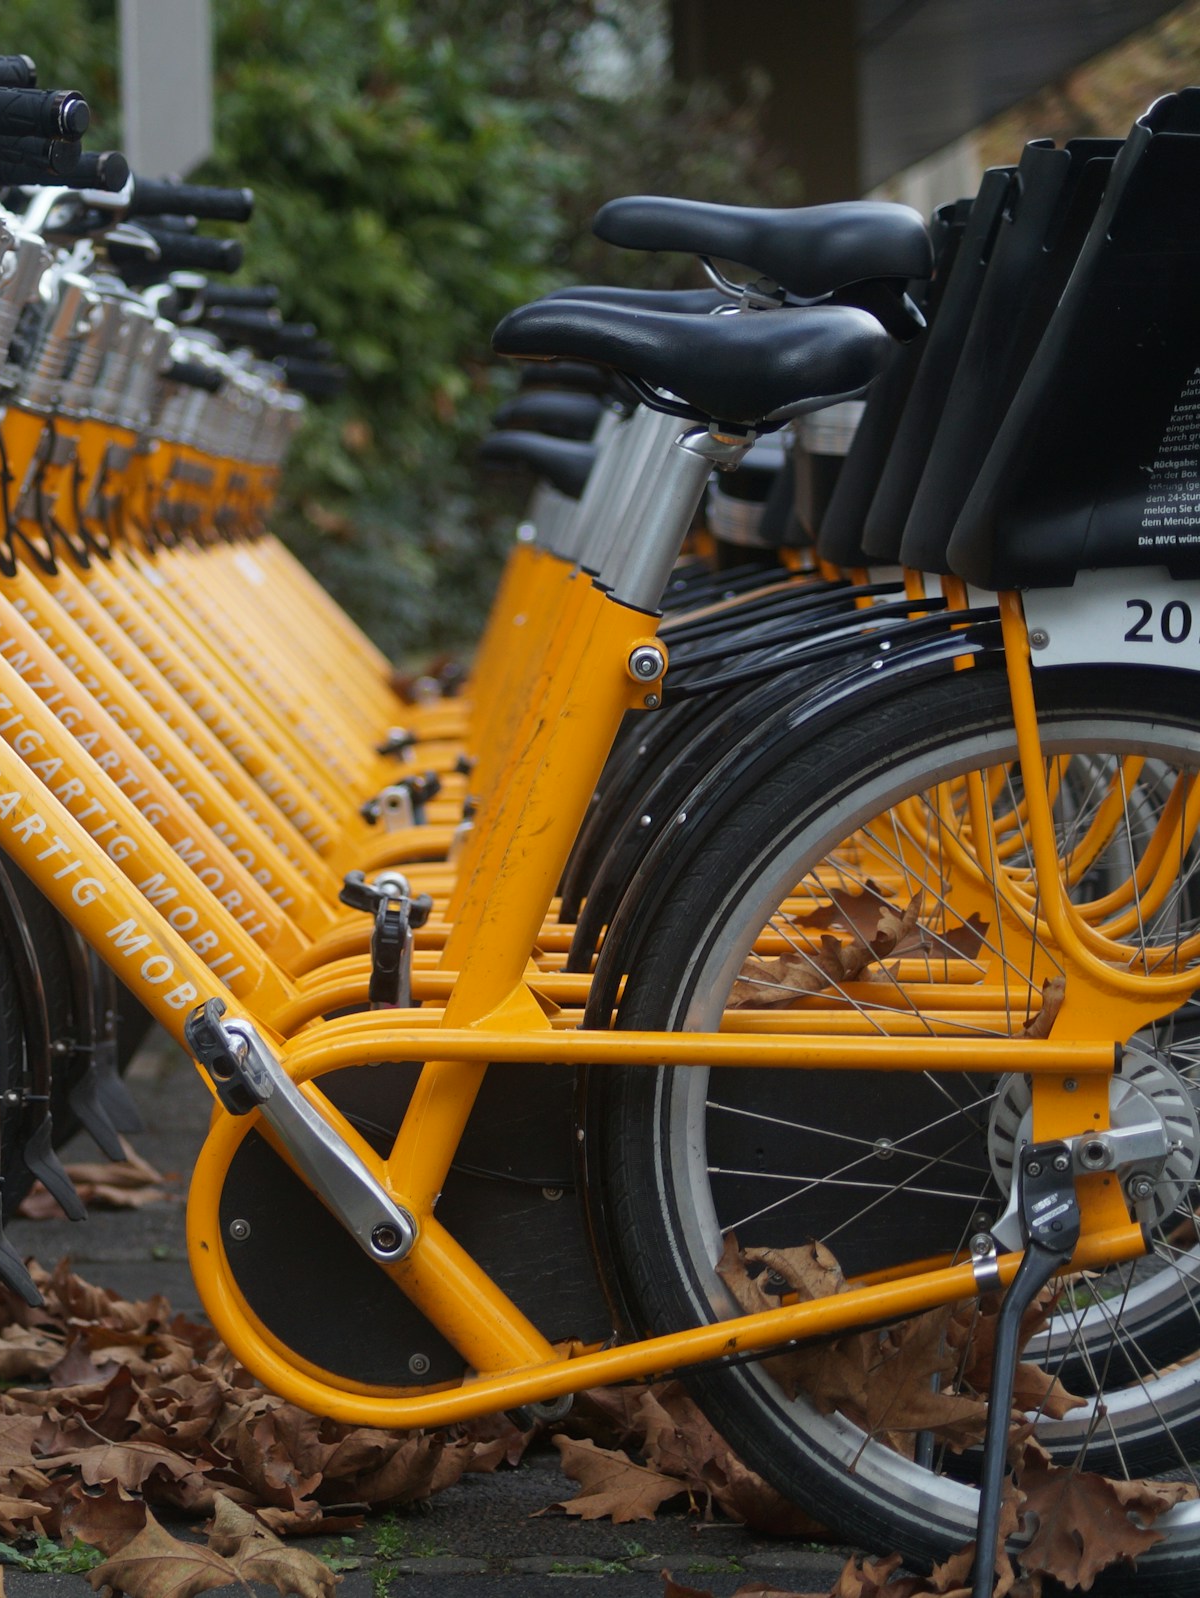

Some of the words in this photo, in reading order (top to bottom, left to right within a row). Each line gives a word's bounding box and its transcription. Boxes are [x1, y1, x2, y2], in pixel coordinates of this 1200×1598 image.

[1170, 413, 1194, 423] Karte
[1162, 433, 1187, 443] durch
[1153, 458, 1198, 469] Rückgabe:
[1164, 471, 1179, 479] der
[1181, 470, 1198, 478] Box
[1145, 494, 1166, 503] dem
[1143, 505, 1177, 515] melden
[1179, 503, 1192, 513] Sie
[1141, 518, 1161, 527] dem
[1138, 536, 1153, 546] Die
[1155, 535, 1176, 545] MVG
[1124, 598, 1200, 645] 20
[139, 871, 246, 990] MOBIL
[105, 918, 198, 1010] MOB
